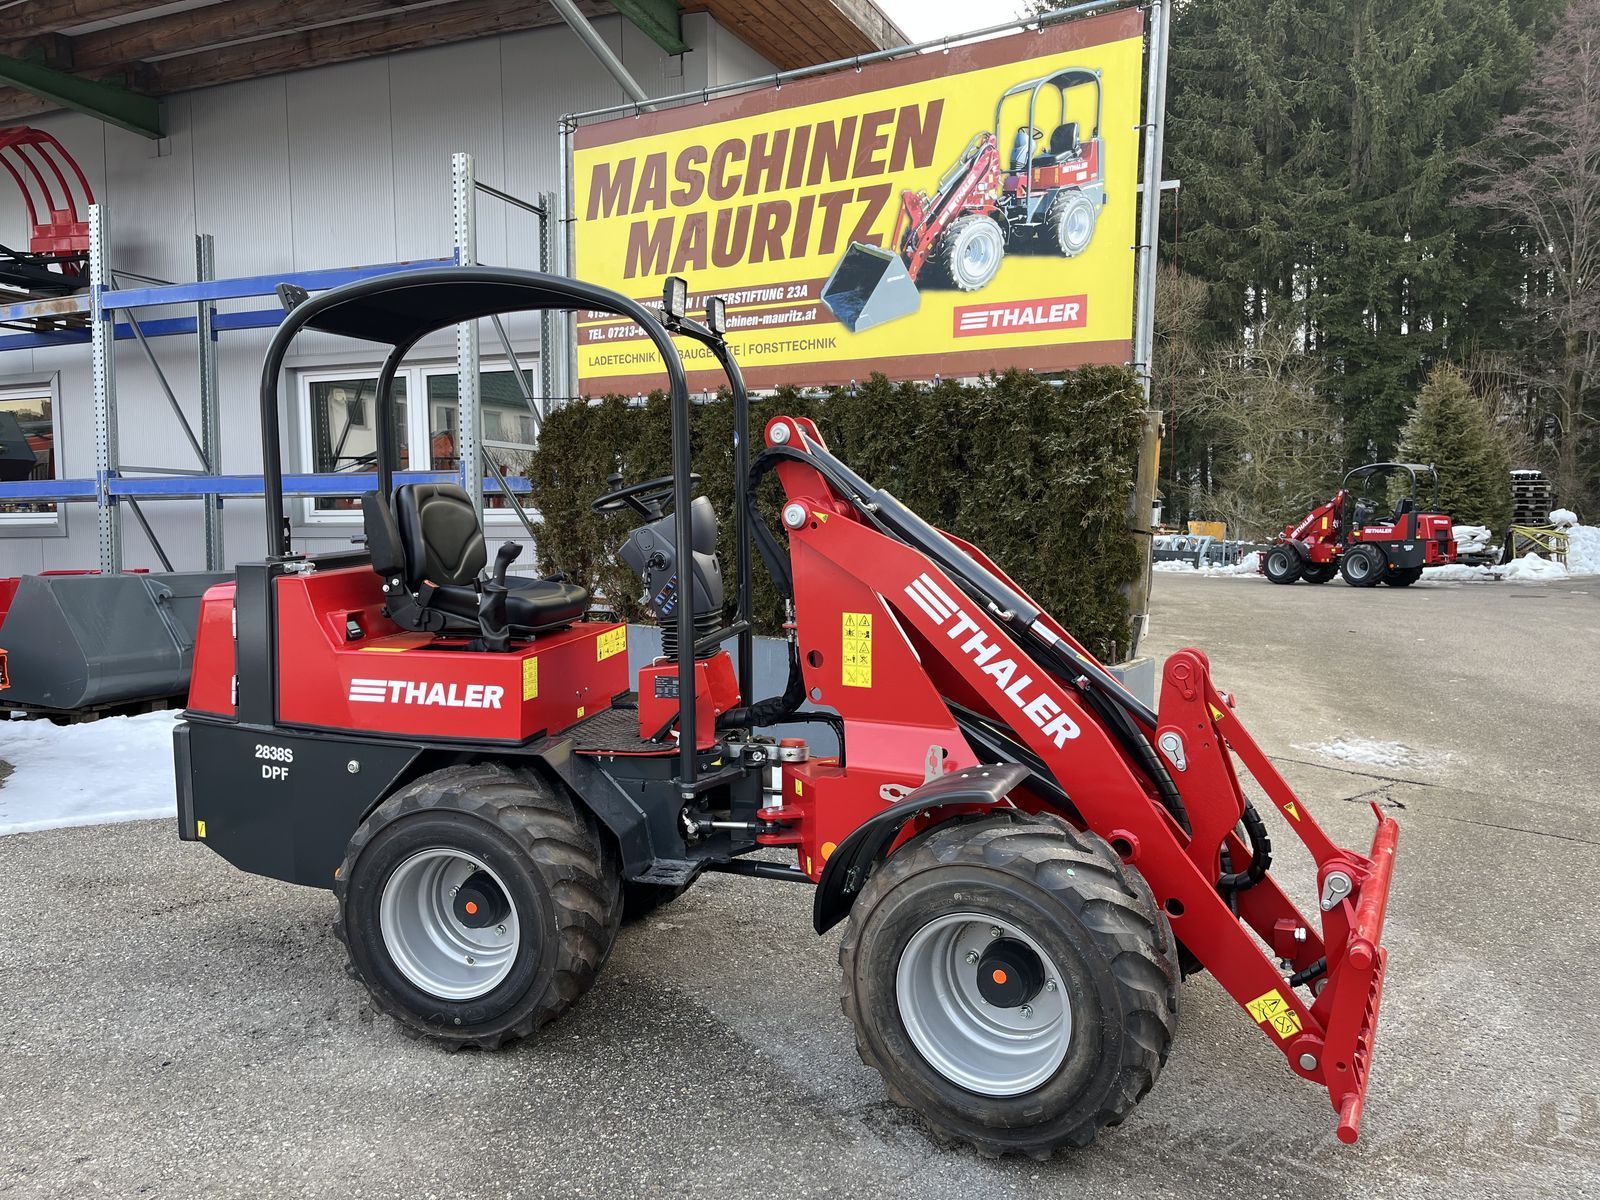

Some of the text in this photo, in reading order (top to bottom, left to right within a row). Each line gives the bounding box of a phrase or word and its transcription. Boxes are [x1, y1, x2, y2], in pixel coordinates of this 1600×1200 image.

[586, 99, 944, 221] MASCHINEN
[624, 183, 892, 279] MAURITZ
[703, 288, 784, 307] UERSTIFTUNG
[786, 284, 808, 298] 23A
[989, 302, 1080, 328] THALER
[588, 328, 606, 341] TEL.
[608, 325, 650, 339] 07213-6
[589, 351, 656, 366] LADETECHNIK
[748, 337, 837, 355] FORSTTECHNIK
[946, 609, 1081, 750] THALER
[387, 680, 505, 709] THALER
[255, 744, 294, 763] 2838S
[262, 764, 289, 781] DPF
